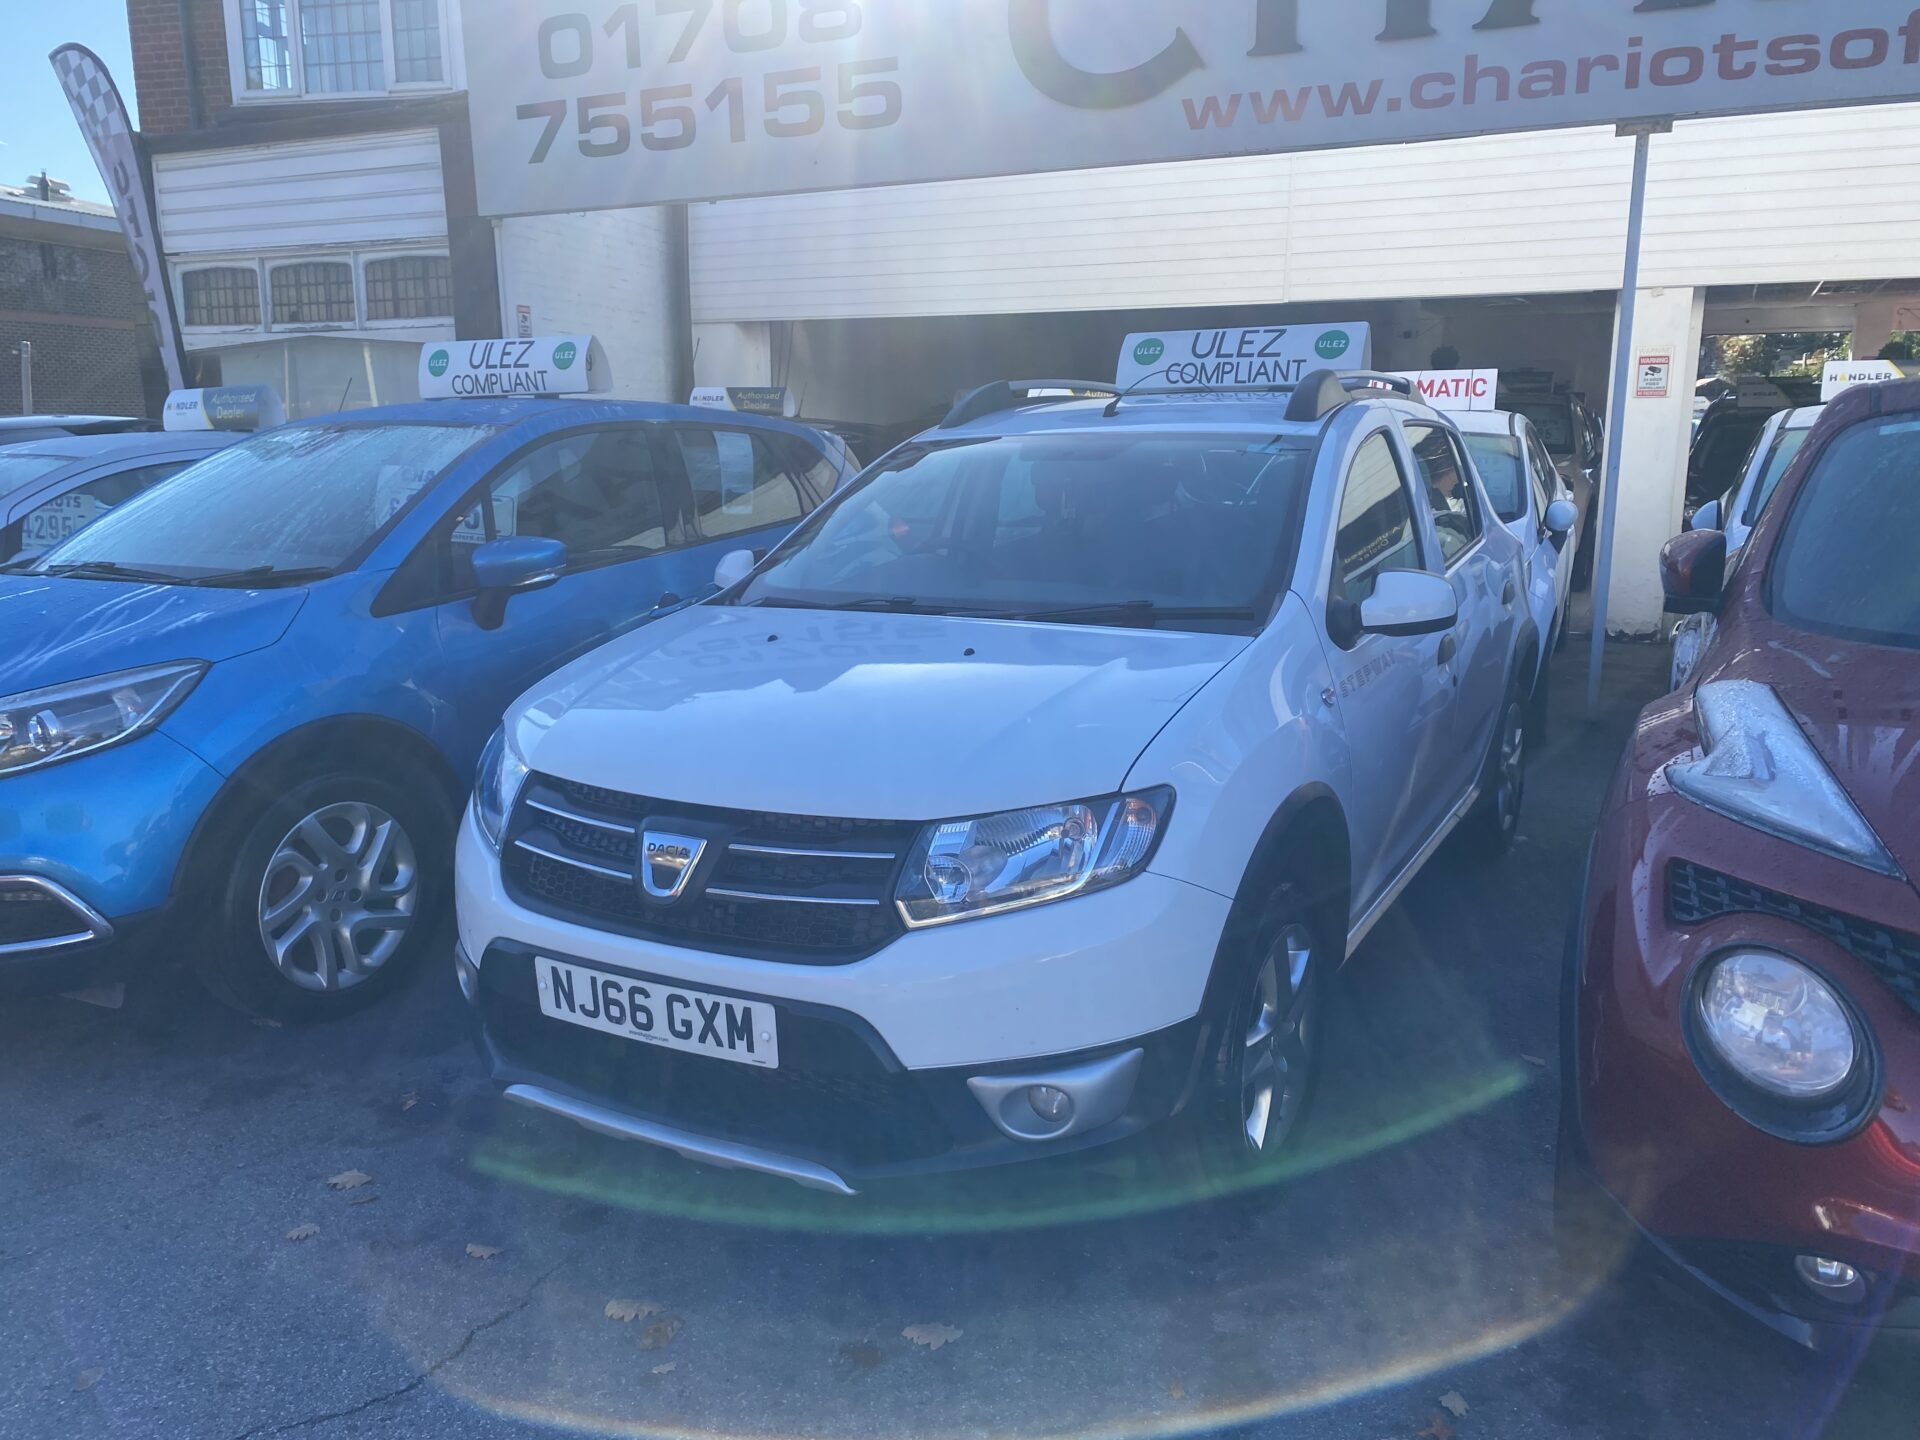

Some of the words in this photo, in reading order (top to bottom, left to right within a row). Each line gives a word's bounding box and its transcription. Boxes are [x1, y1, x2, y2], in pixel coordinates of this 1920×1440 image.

[538, 0, 862, 80] 01708
[516, 56, 902, 164] 755155
[469, 341, 535, 369] ULEZ
[554, 351, 575, 360] ULEZ
[1136, 345, 1161, 355] ULEZ
[1191, 329, 1288, 358] ULEZ
[1319, 339, 1346, 349] ULEZ
[452, 370, 548, 395] COMPLIANT
[1165, 359, 1307, 385] COMPLIANT
[736, 391, 780, 400] Authorised
[743, 400, 770, 409] Dealer
[216, 406, 245, 419] Dealer
[1339, 649, 1396, 698] STEPWAY
[647, 842, 690, 857] DACIA
[550, 965, 654, 1032] NJ66
[665, 992, 755, 1054] GXM
